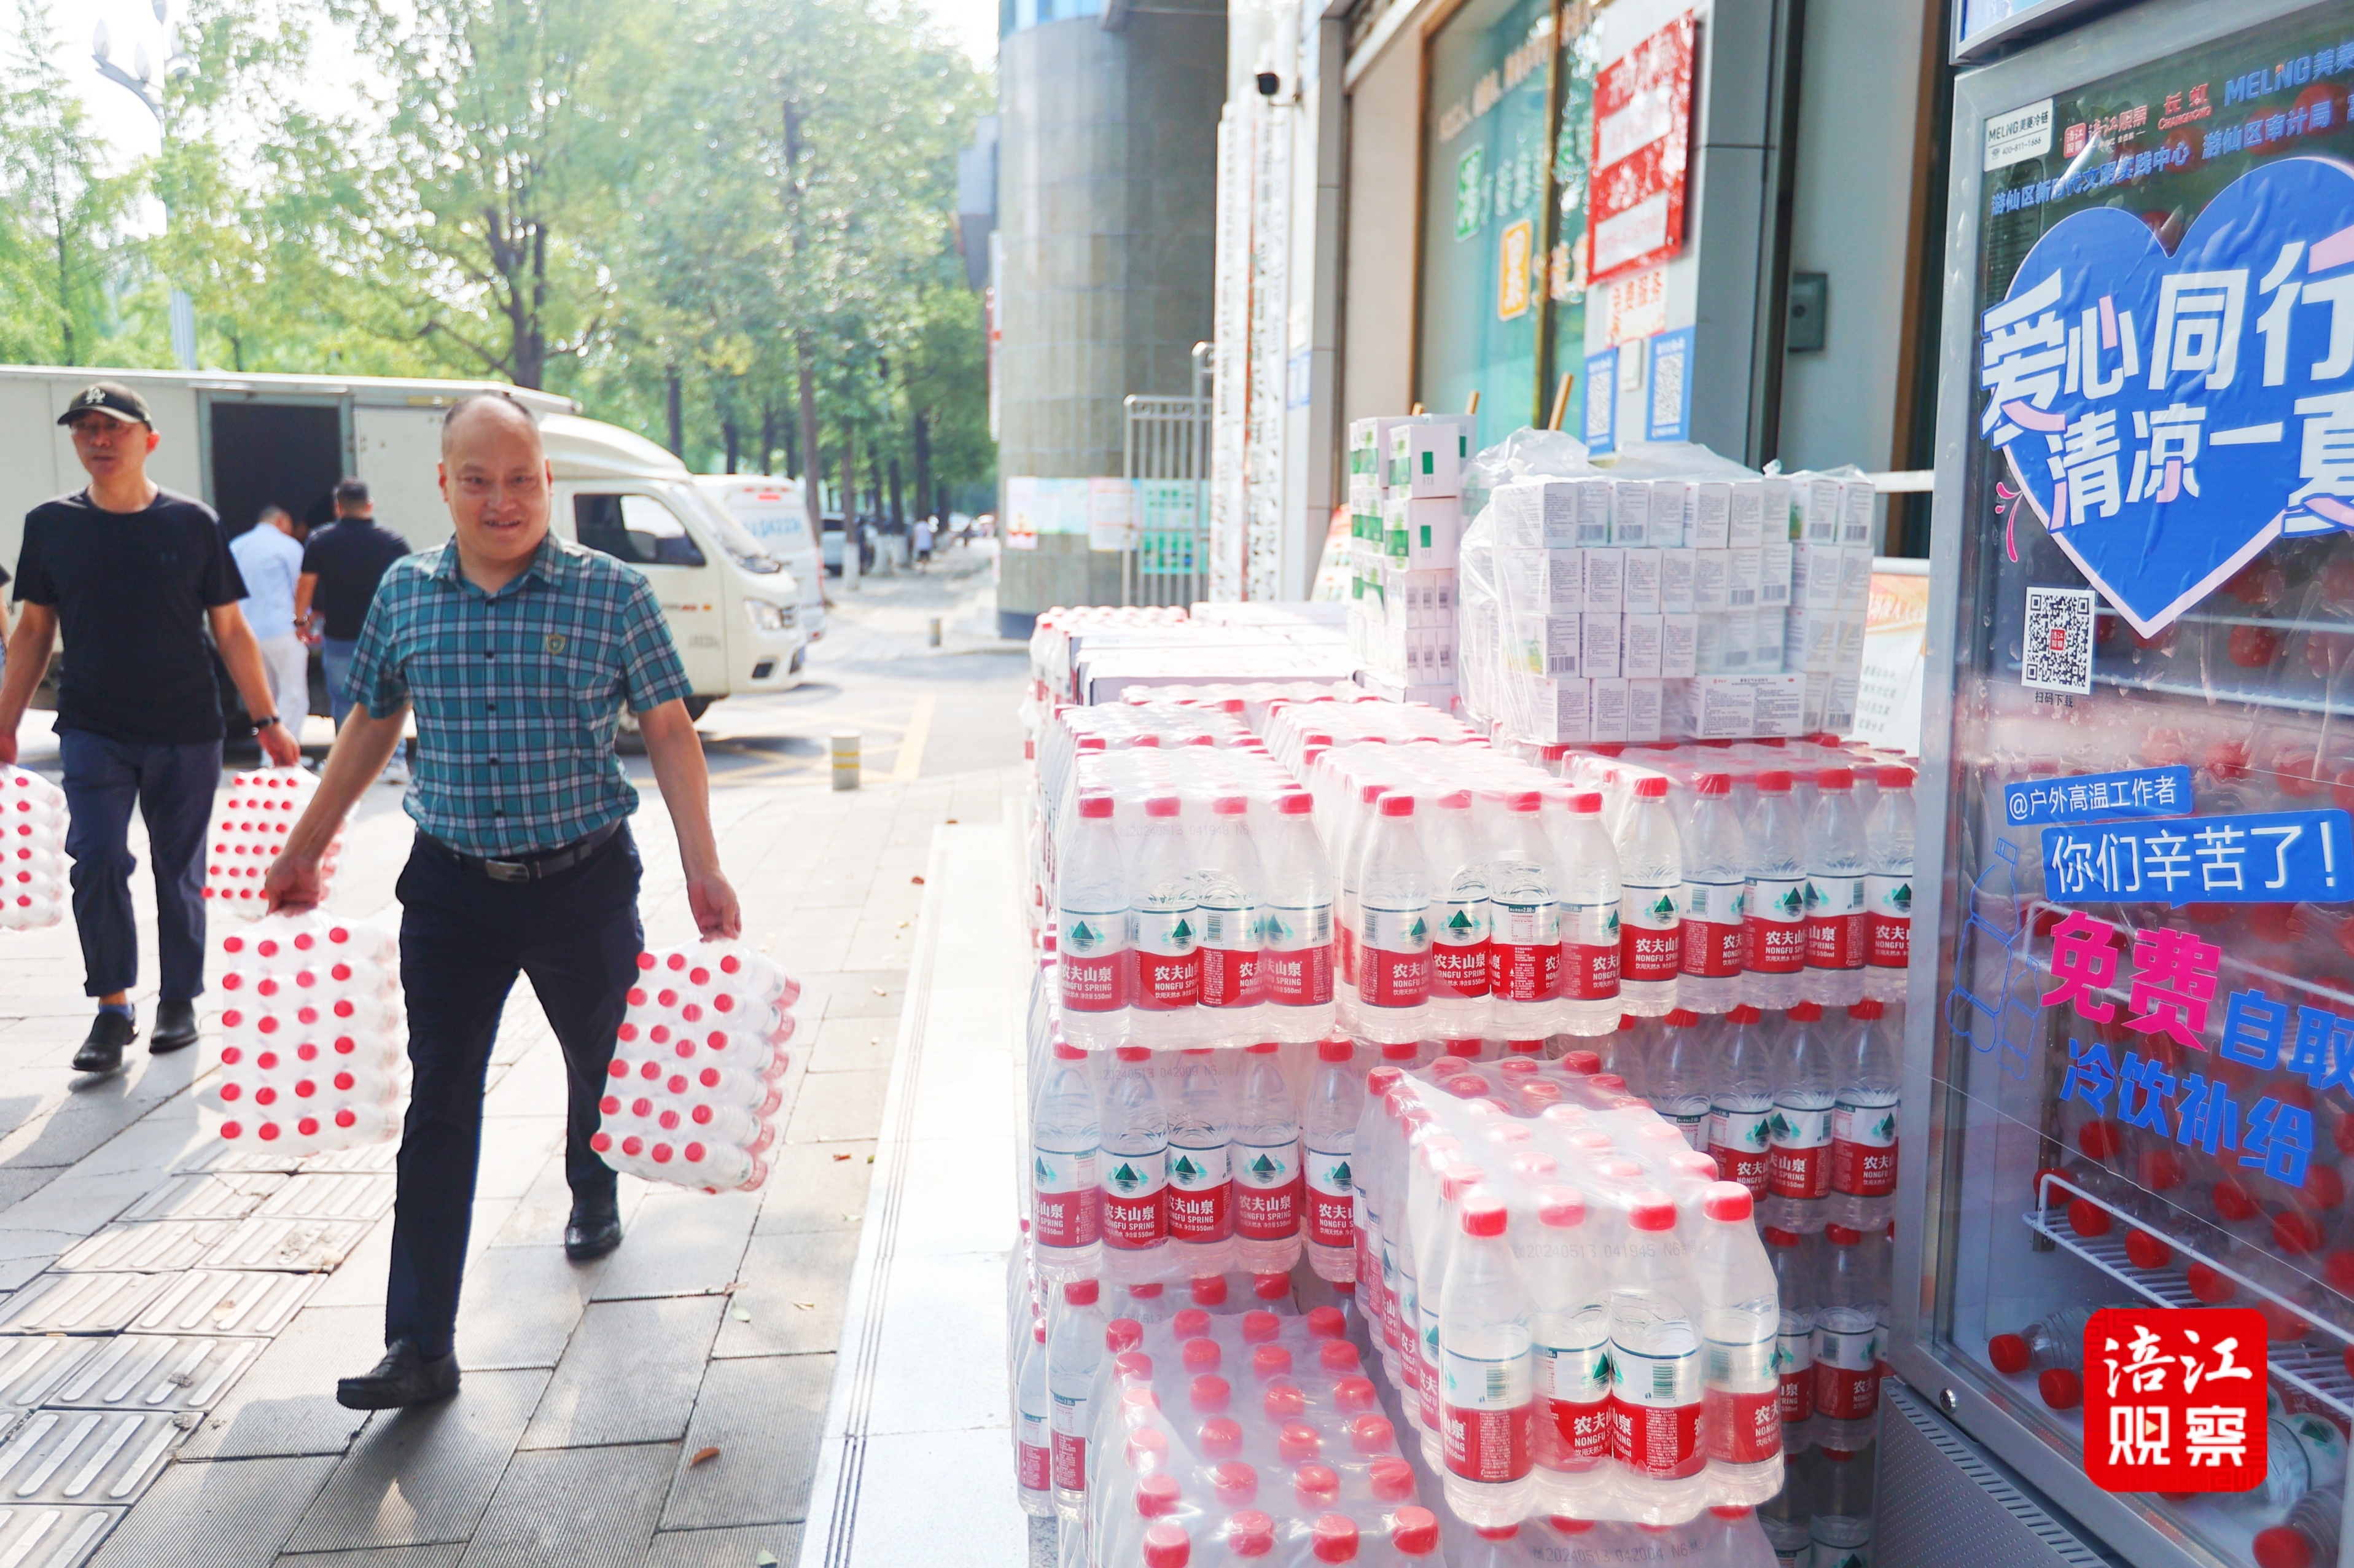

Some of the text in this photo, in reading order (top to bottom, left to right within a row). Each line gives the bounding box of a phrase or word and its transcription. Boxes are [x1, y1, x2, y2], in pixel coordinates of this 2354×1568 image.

[2164, 83, 2209, 115] 长虹
[2019, 111, 2048, 133] 美菱冷链
[2157, 105, 2212, 131] CHANGHONG
[2202, 101, 2332, 160] 游仙区审计局
[2002, 136, 2042, 156] 400-811-1666
[1982, 226, 2354, 448] 爱心同行
[2046, 391, 2354, 533] 清凉一夏
[2035, 691, 2073, 708] 扫码下载
[2009, 774, 2177, 820] @户外高温工作者
[1809, 941, 1835, 950] SPRING
[1875, 940, 1904, 949] NONGFU
[1433, 953, 1486, 970] 农夫山泉
[1464, 969, 1485, 978] SPRING
[1593, 971, 1616, 981] NONGFU
[1085, 983, 1112, 991] SPRING
[1155, 981, 1183, 991] NONGFU
[1276, 977, 1301, 986] SPRING
[1393, 979, 1421, 988] NONGFU
[2041, 910, 2354, 1098] 免费 自取
[1104, 1067, 1155, 1081] 20240513
[2059, 1038, 2313, 1188] 冷饮补给
[1737, 1176, 1762, 1185] NONGFU
[1779, 1171, 1806, 1182] SPRING
[1239, 1195, 1292, 1211] 农夫山泉
[1105, 1204, 1155, 1222] 农夫山泉
[1240, 1211, 1292, 1221] NONGFU SPRING
[1040, 1218, 1064, 1228] SPRING
[1129, 1222, 1155, 1231] SPRING
[1319, 1219, 1347, 1228] NONGFU
[1526, 1244, 1596, 1258] 20240513
[1604, 1243, 1656, 1258] 041945
[1574, 1433, 1606, 1447] NONGFU
[1546, 1547, 1612, 1563] 20240513
[1615, 1547, 1664, 1562] 042004
